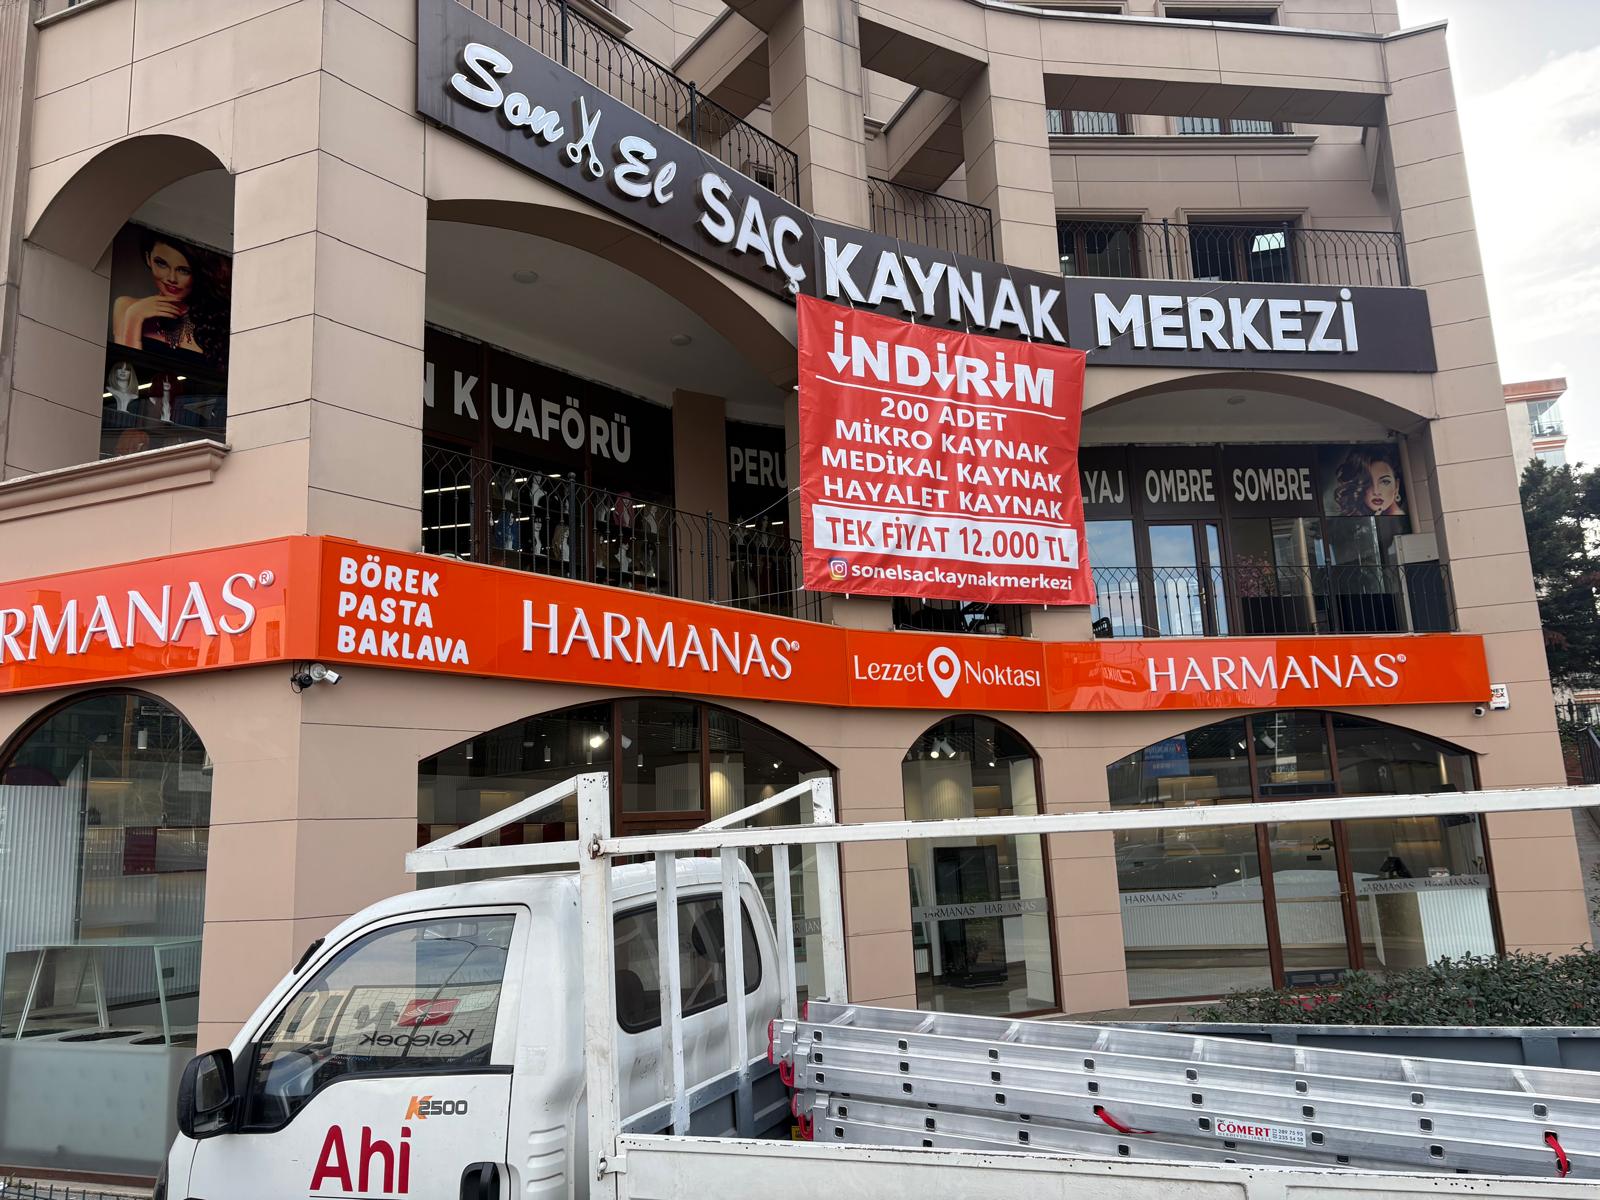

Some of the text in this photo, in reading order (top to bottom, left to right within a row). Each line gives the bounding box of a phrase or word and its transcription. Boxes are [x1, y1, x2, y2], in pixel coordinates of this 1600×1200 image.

[451, 43, 1359, 353] Son El SAÇ KAYNAK MERKEZİ
[880, 396, 1007, 432] 200 ADET
[835, 418, 1049, 465] MİKRO KAYNAK
[821, 446, 1062, 494] MEDİKAL KAYNAK
[1145, 468, 1215, 503] OMBRE
[1233, 467, 1313, 501] SOMBRE
[823, 476, 1062, 520] HAYALET KAYNAK
[826, 516, 1070, 562] TEK FİYAT 12.000 TL
[339, 554, 439, 597] BÖREK
[851, 562, 1073, 591] sonelsackaynakmerkezi
[338, 591, 433, 628] PASTA
[337, 625, 469, 665] BAKLAVA
[854, 654, 1041, 687] Lezzet Noktası
[309, 1125, 411, 1193] Ahi
